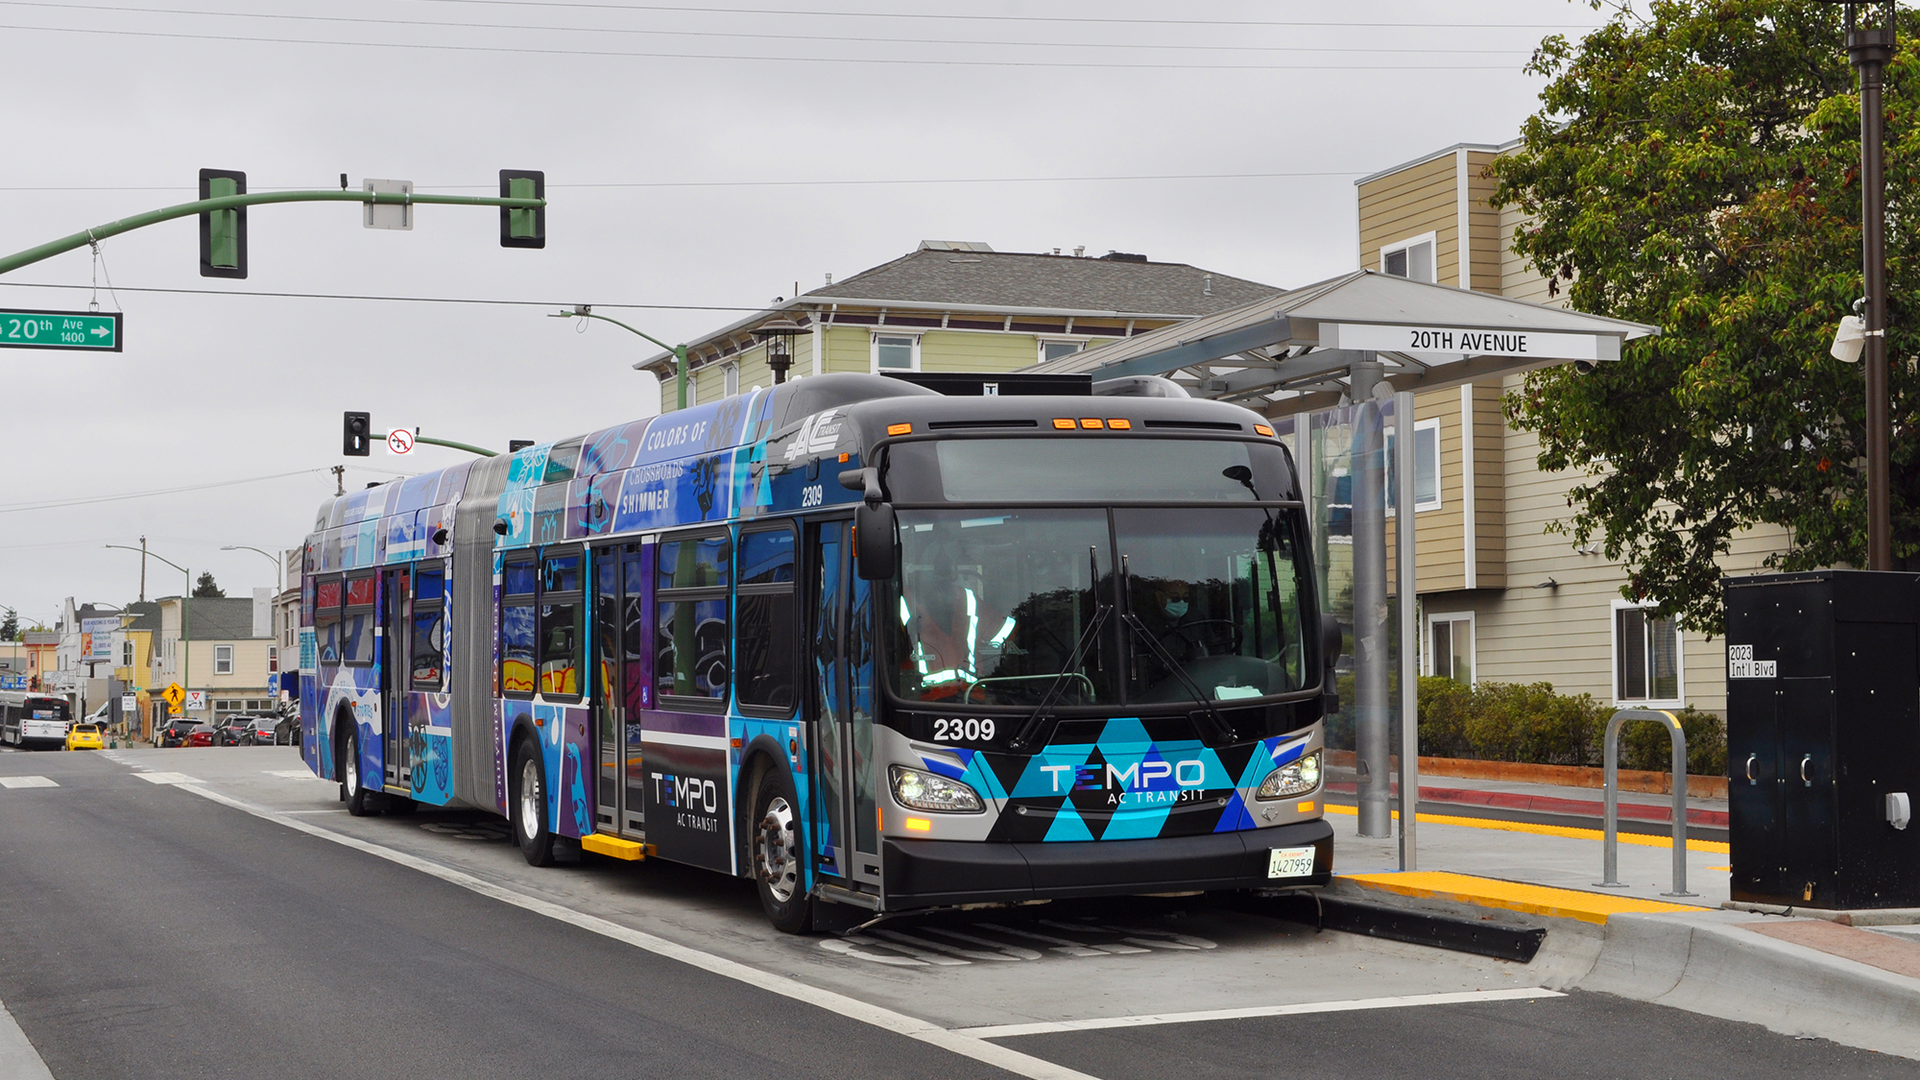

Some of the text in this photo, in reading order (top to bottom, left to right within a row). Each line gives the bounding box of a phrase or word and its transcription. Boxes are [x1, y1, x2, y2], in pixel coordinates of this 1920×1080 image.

[8, 318, 84, 340] 20th Ave
[60, 332, 85, 343] 1400
[1410, 330, 1528, 353] 20TH AVENUE
[647, 420, 708, 452] COLORS OF
[783, 409, 838, 461] AC
[818, 422, 842, 437] TRANSIT
[629, 460, 684, 486] CROSSROADS
[622, 489, 669, 515] SHIMMER
[802, 484, 823, 507] 2309
[1730, 647, 1752, 661] 2023
[1754, 662, 1774, 677] Blvd
[933, 718, 996, 741] 2309
[1039, 759, 1206, 791] TEMPO
[651, 771, 718, 814] TEMPO
[1107, 788, 1206, 805] AC TRANSIT
[676, 812, 718, 833] AC TRANSIT
[1271, 858, 1313, 874] 1427959
